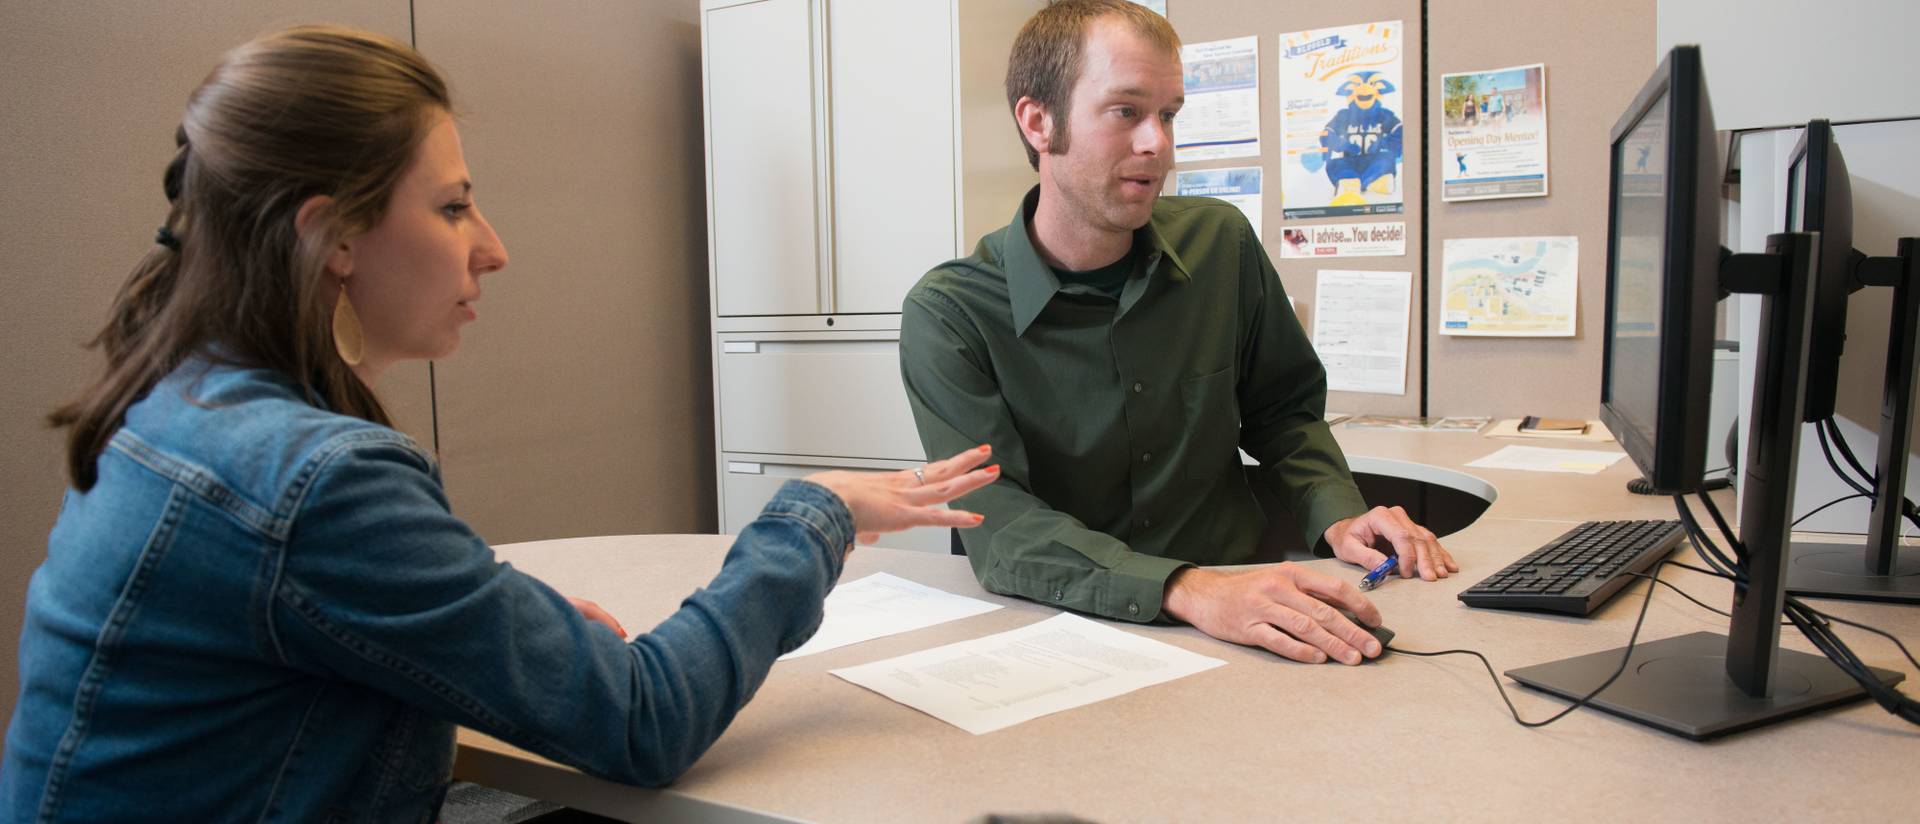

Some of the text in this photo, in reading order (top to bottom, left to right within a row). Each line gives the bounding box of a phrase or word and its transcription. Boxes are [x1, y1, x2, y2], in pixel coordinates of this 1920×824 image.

[1304, 43, 1390, 79] Traditions
[1448, 134, 1484, 148] Opening
[1487, 133, 1502, 145] Day
[1311, 228, 1315, 244] I
[1371, 225, 1403, 241] decide!
